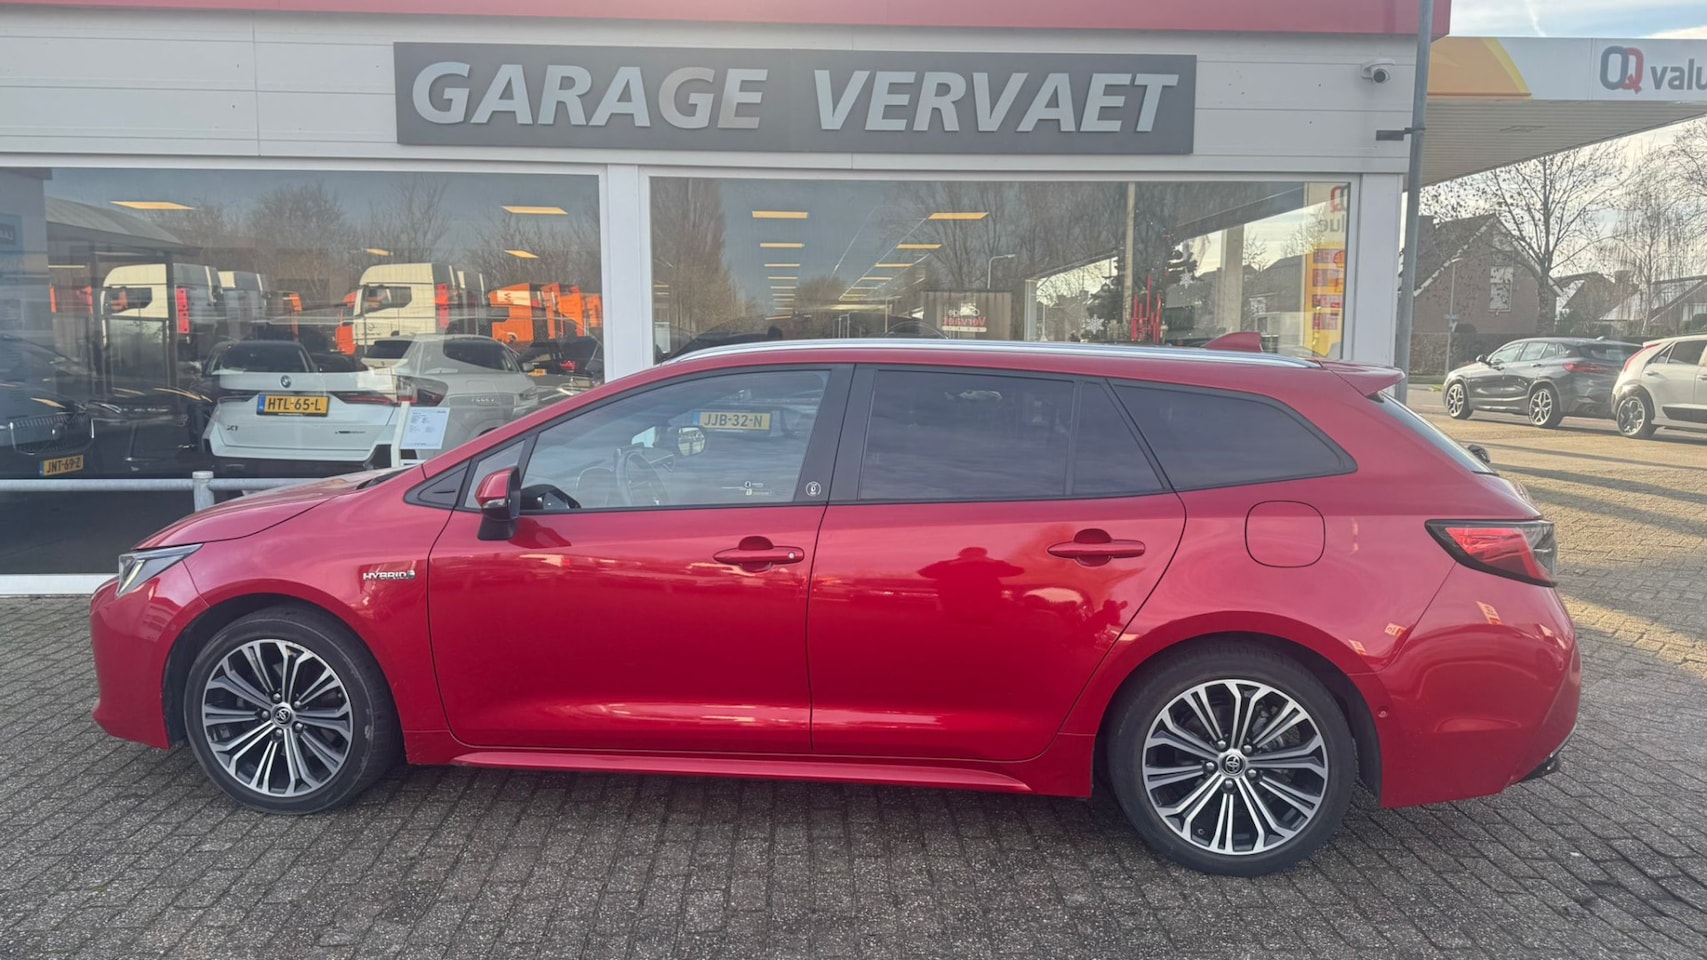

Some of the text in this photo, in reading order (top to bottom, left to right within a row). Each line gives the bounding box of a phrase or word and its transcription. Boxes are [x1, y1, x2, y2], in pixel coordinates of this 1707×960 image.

[1600, 45, 1707, 95] OQ valu
[412, 61, 1179, 133] GARAGE VERVAET
[266, 398, 322, 412] HTL-65-L
[704, 413, 764, 428] JJB-32-N
[46, 457, 81, 473] JNT-69-Z
[362, 571, 407, 580] HYBRID
